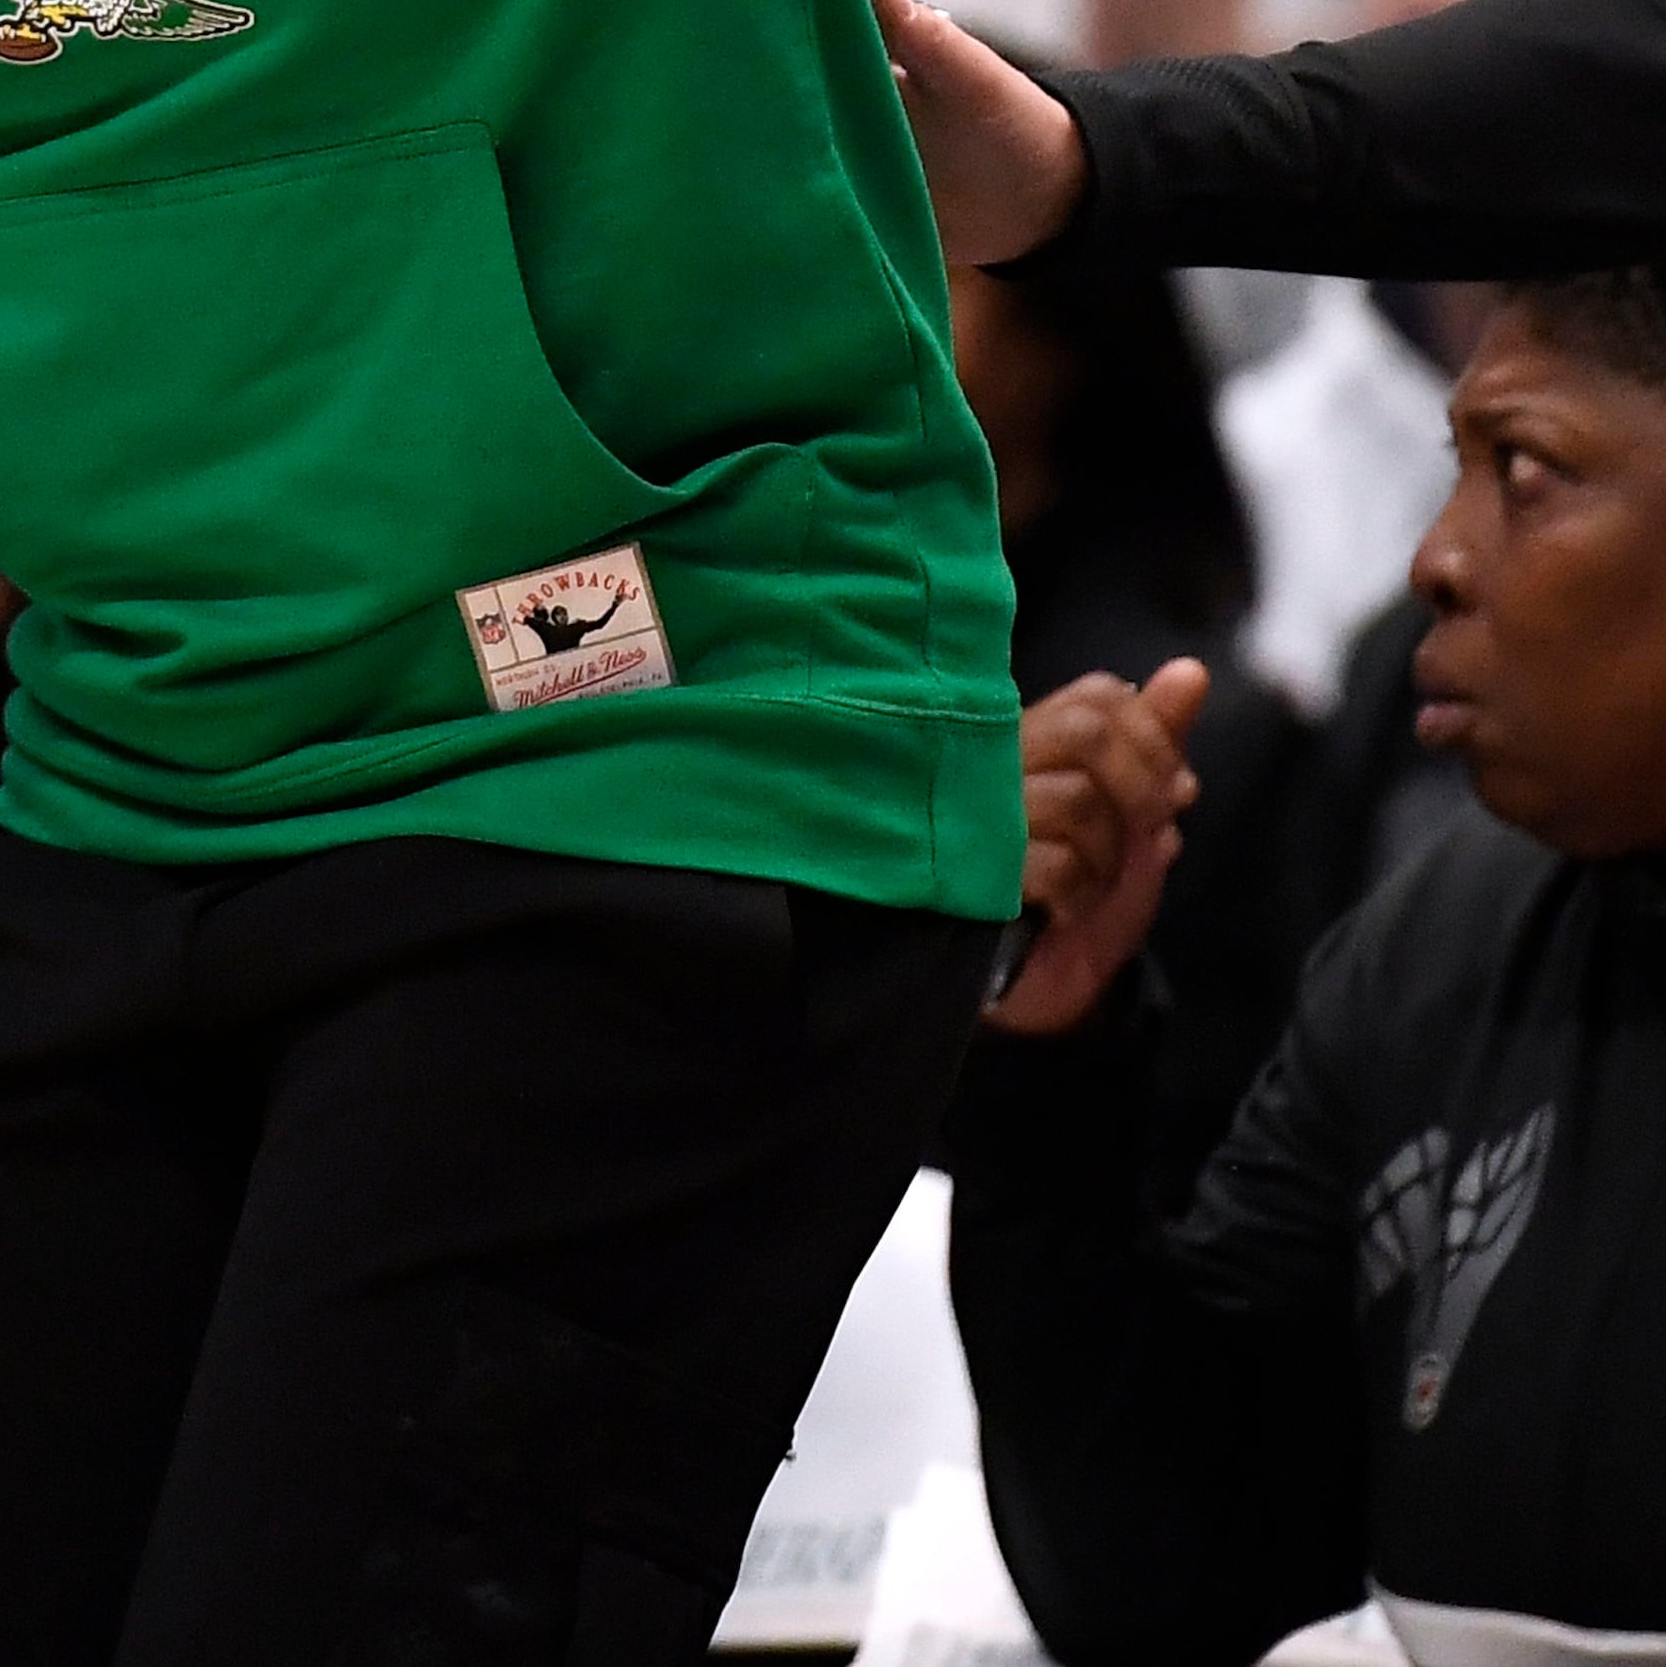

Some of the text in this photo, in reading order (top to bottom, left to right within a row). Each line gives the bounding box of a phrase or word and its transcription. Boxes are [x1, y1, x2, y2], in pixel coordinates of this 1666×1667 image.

[513, 572, 640, 625] THROWBACKS
[513, 665, 584, 707] Mitchell
[600, 646, 647, 673] Ness
